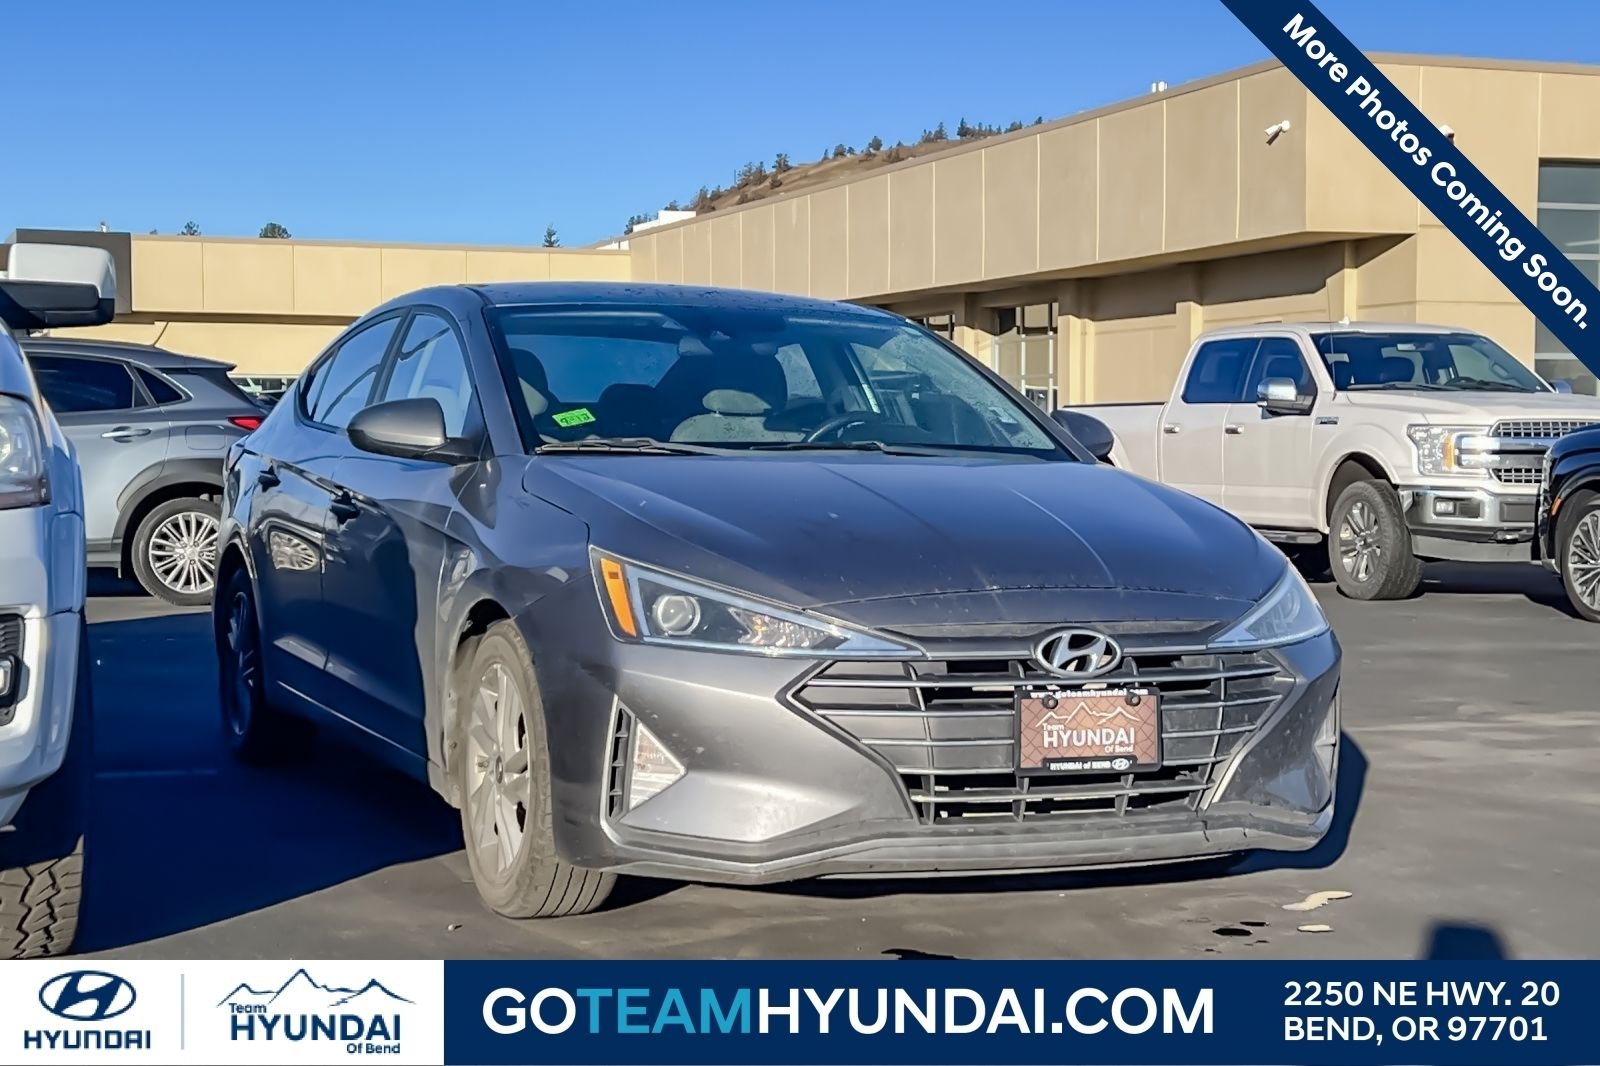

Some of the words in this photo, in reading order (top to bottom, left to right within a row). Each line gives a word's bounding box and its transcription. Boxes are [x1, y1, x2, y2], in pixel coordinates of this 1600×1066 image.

[1042, 723, 1065, 731] Team
[1043, 727, 1135, 748] HYUNDAI
[1104, 745, 1114, 753] Of
